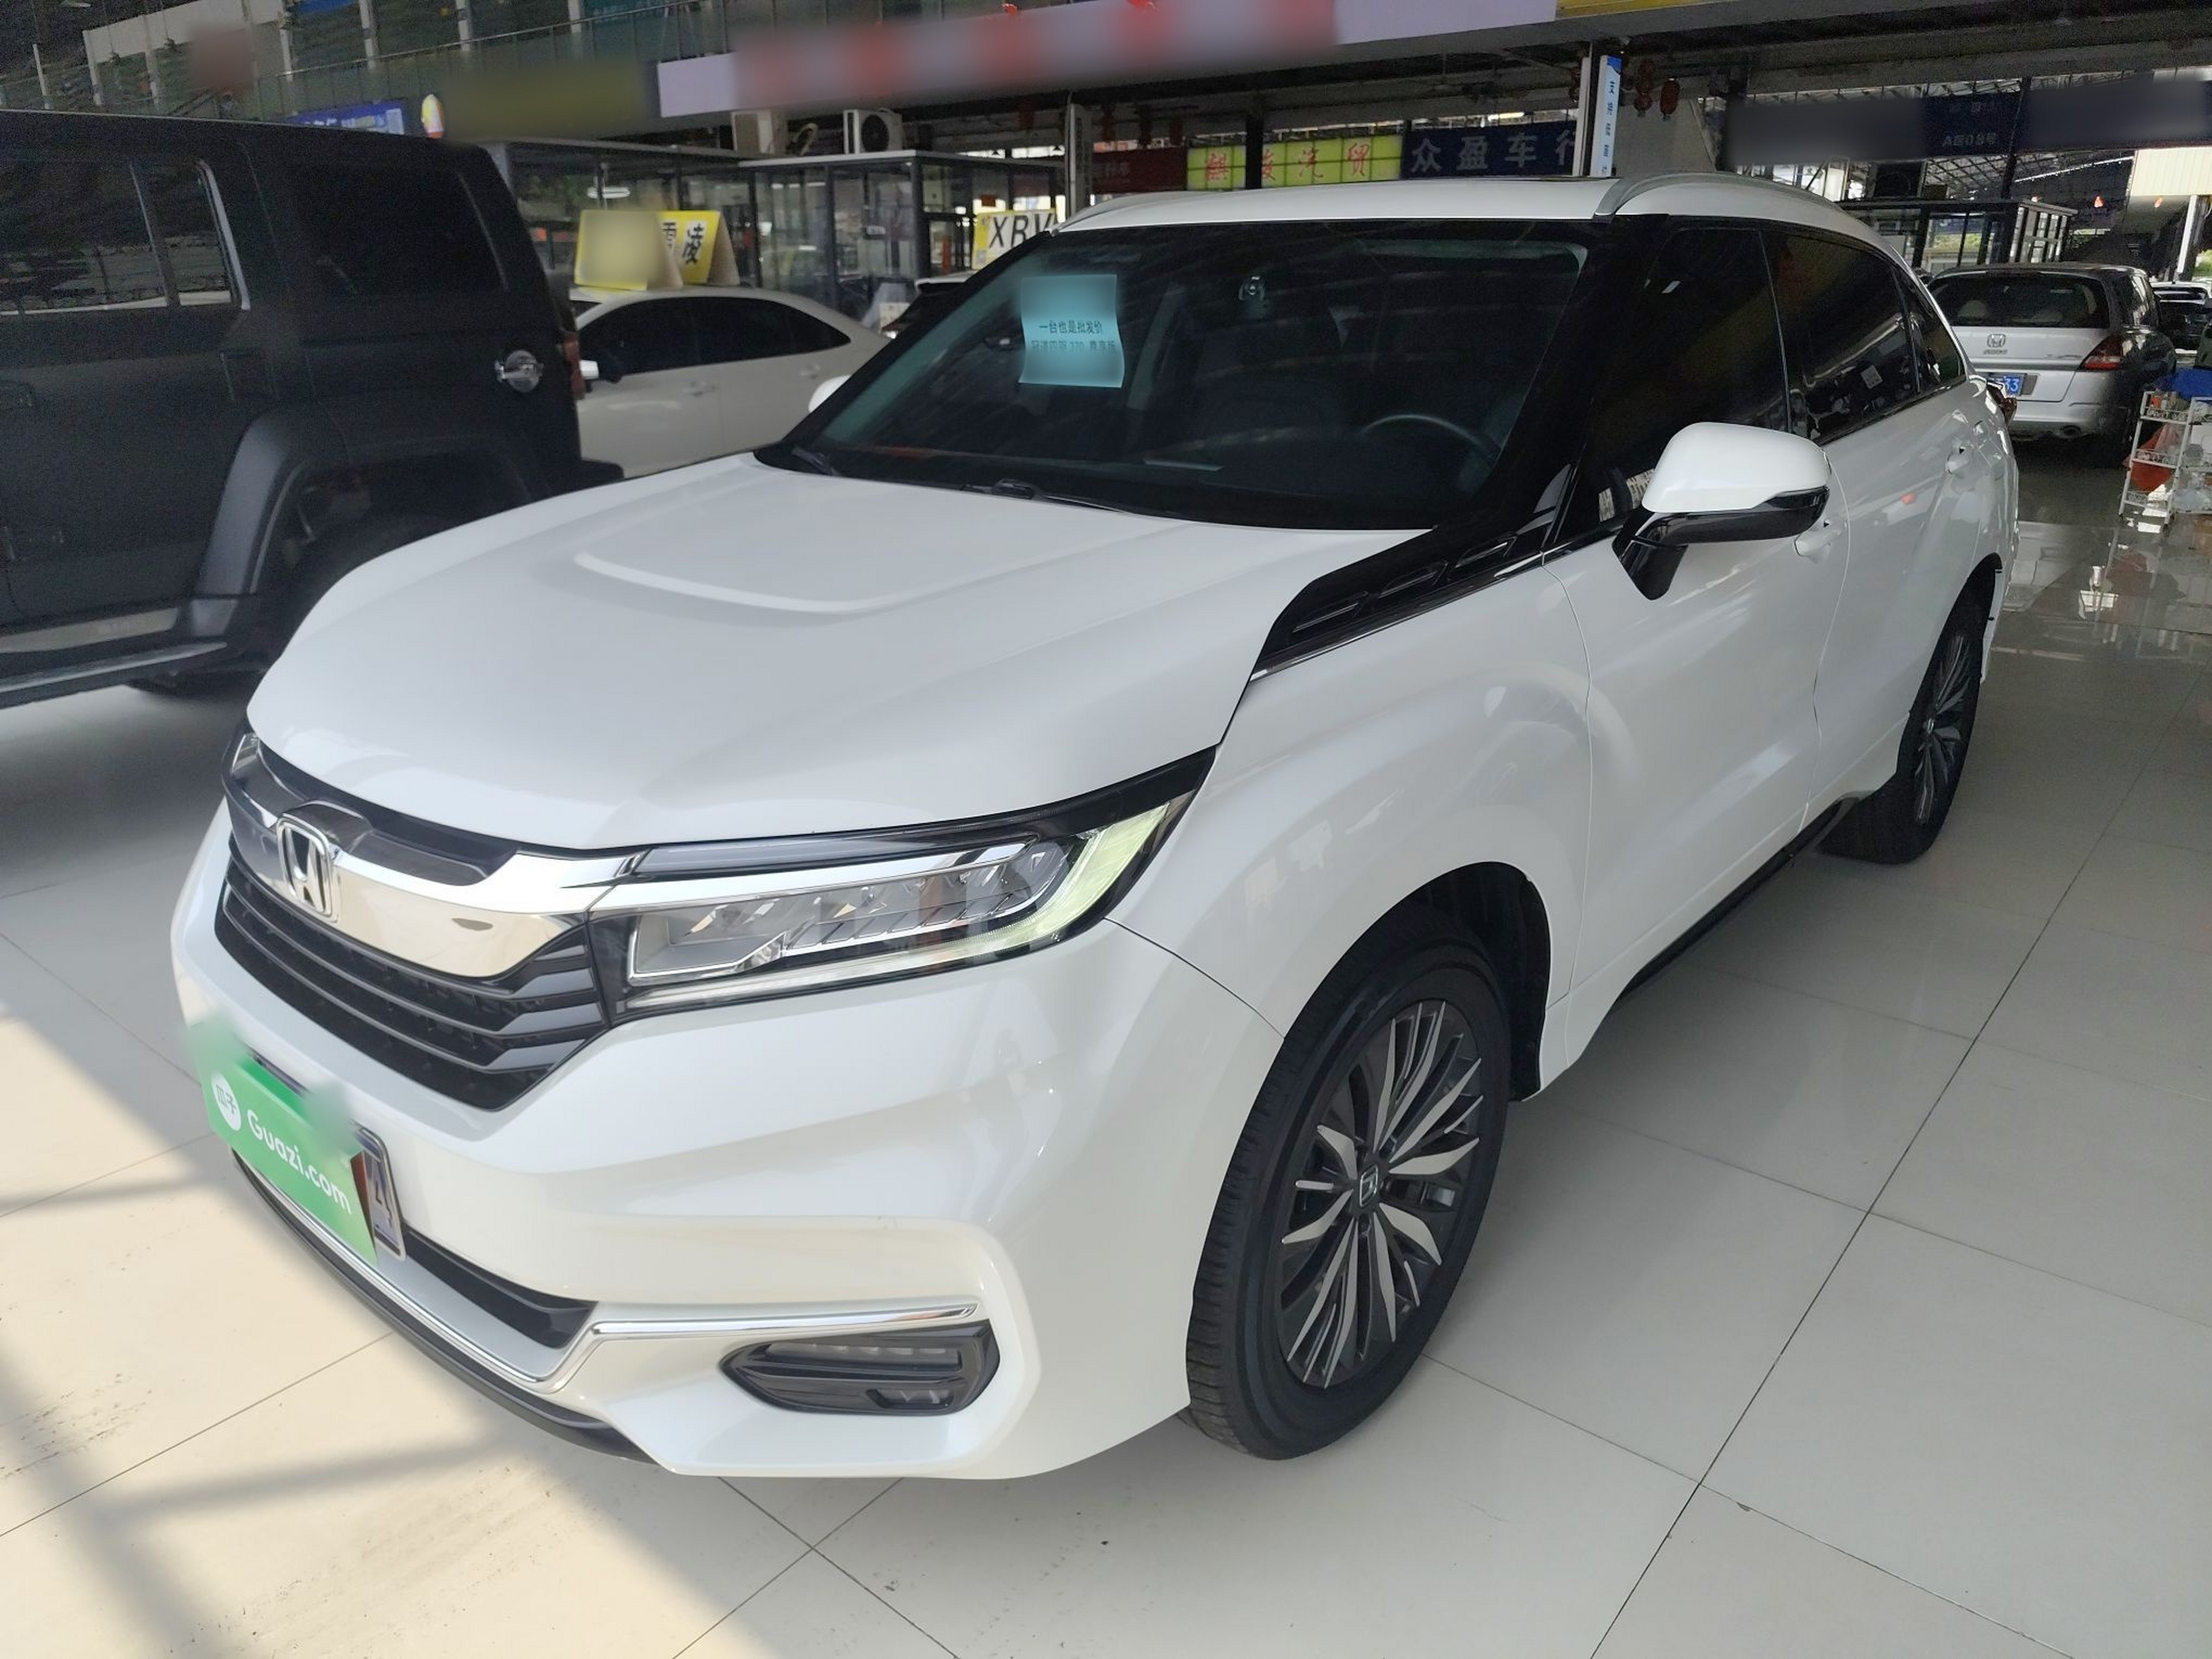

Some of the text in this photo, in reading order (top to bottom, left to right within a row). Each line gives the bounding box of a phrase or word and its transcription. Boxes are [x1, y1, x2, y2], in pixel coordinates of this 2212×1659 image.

[1039, 320, 1103, 334] 一台也是批发价
[247, 1109, 351, 1215] Guazi.com
